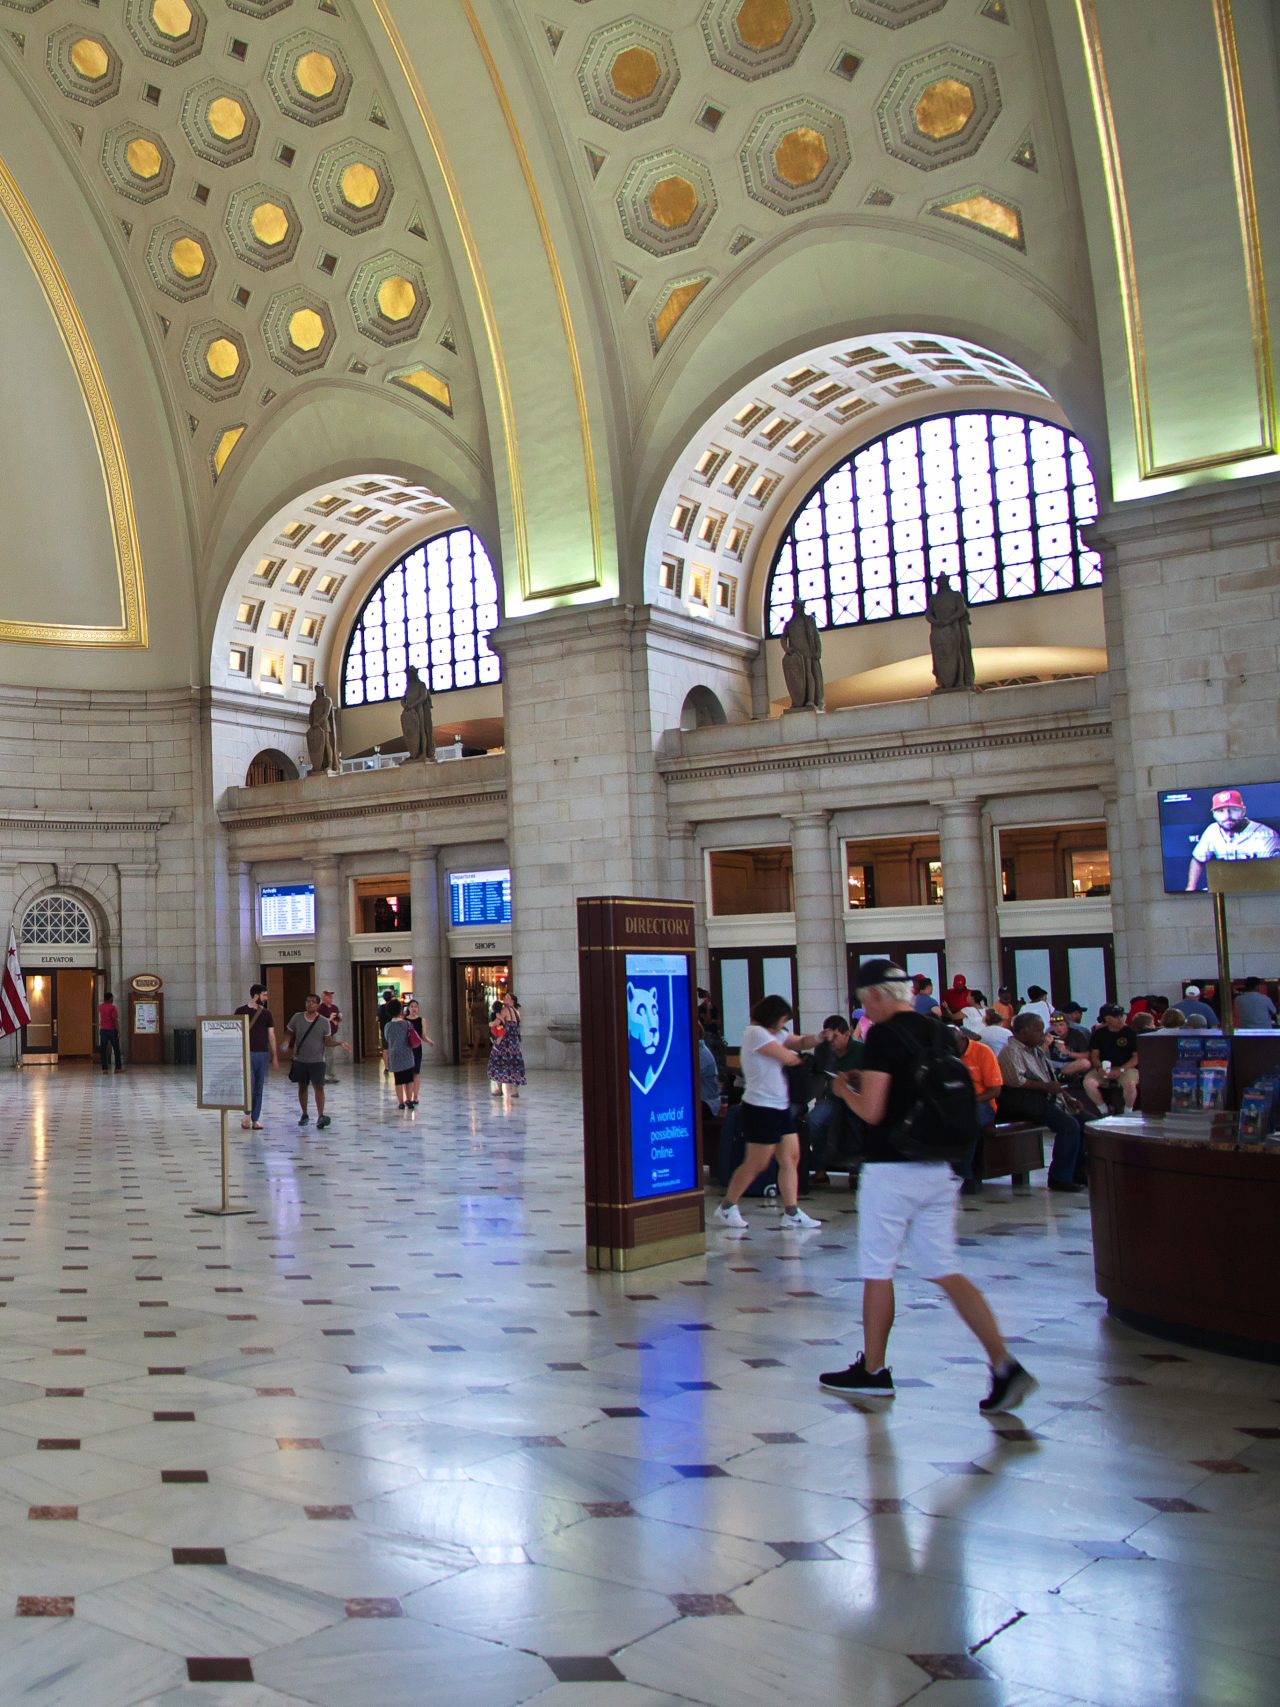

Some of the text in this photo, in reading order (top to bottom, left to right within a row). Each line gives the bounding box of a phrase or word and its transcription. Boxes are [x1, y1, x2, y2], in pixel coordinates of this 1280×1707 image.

[1188, 834, 1200, 842] WE
[625, 916, 690, 937] DIRECTORY
[650, 1107, 684, 1123] A world of
[650, 1126, 690, 1144] possibilities.
[651, 1146, 675, 1160] Online.
